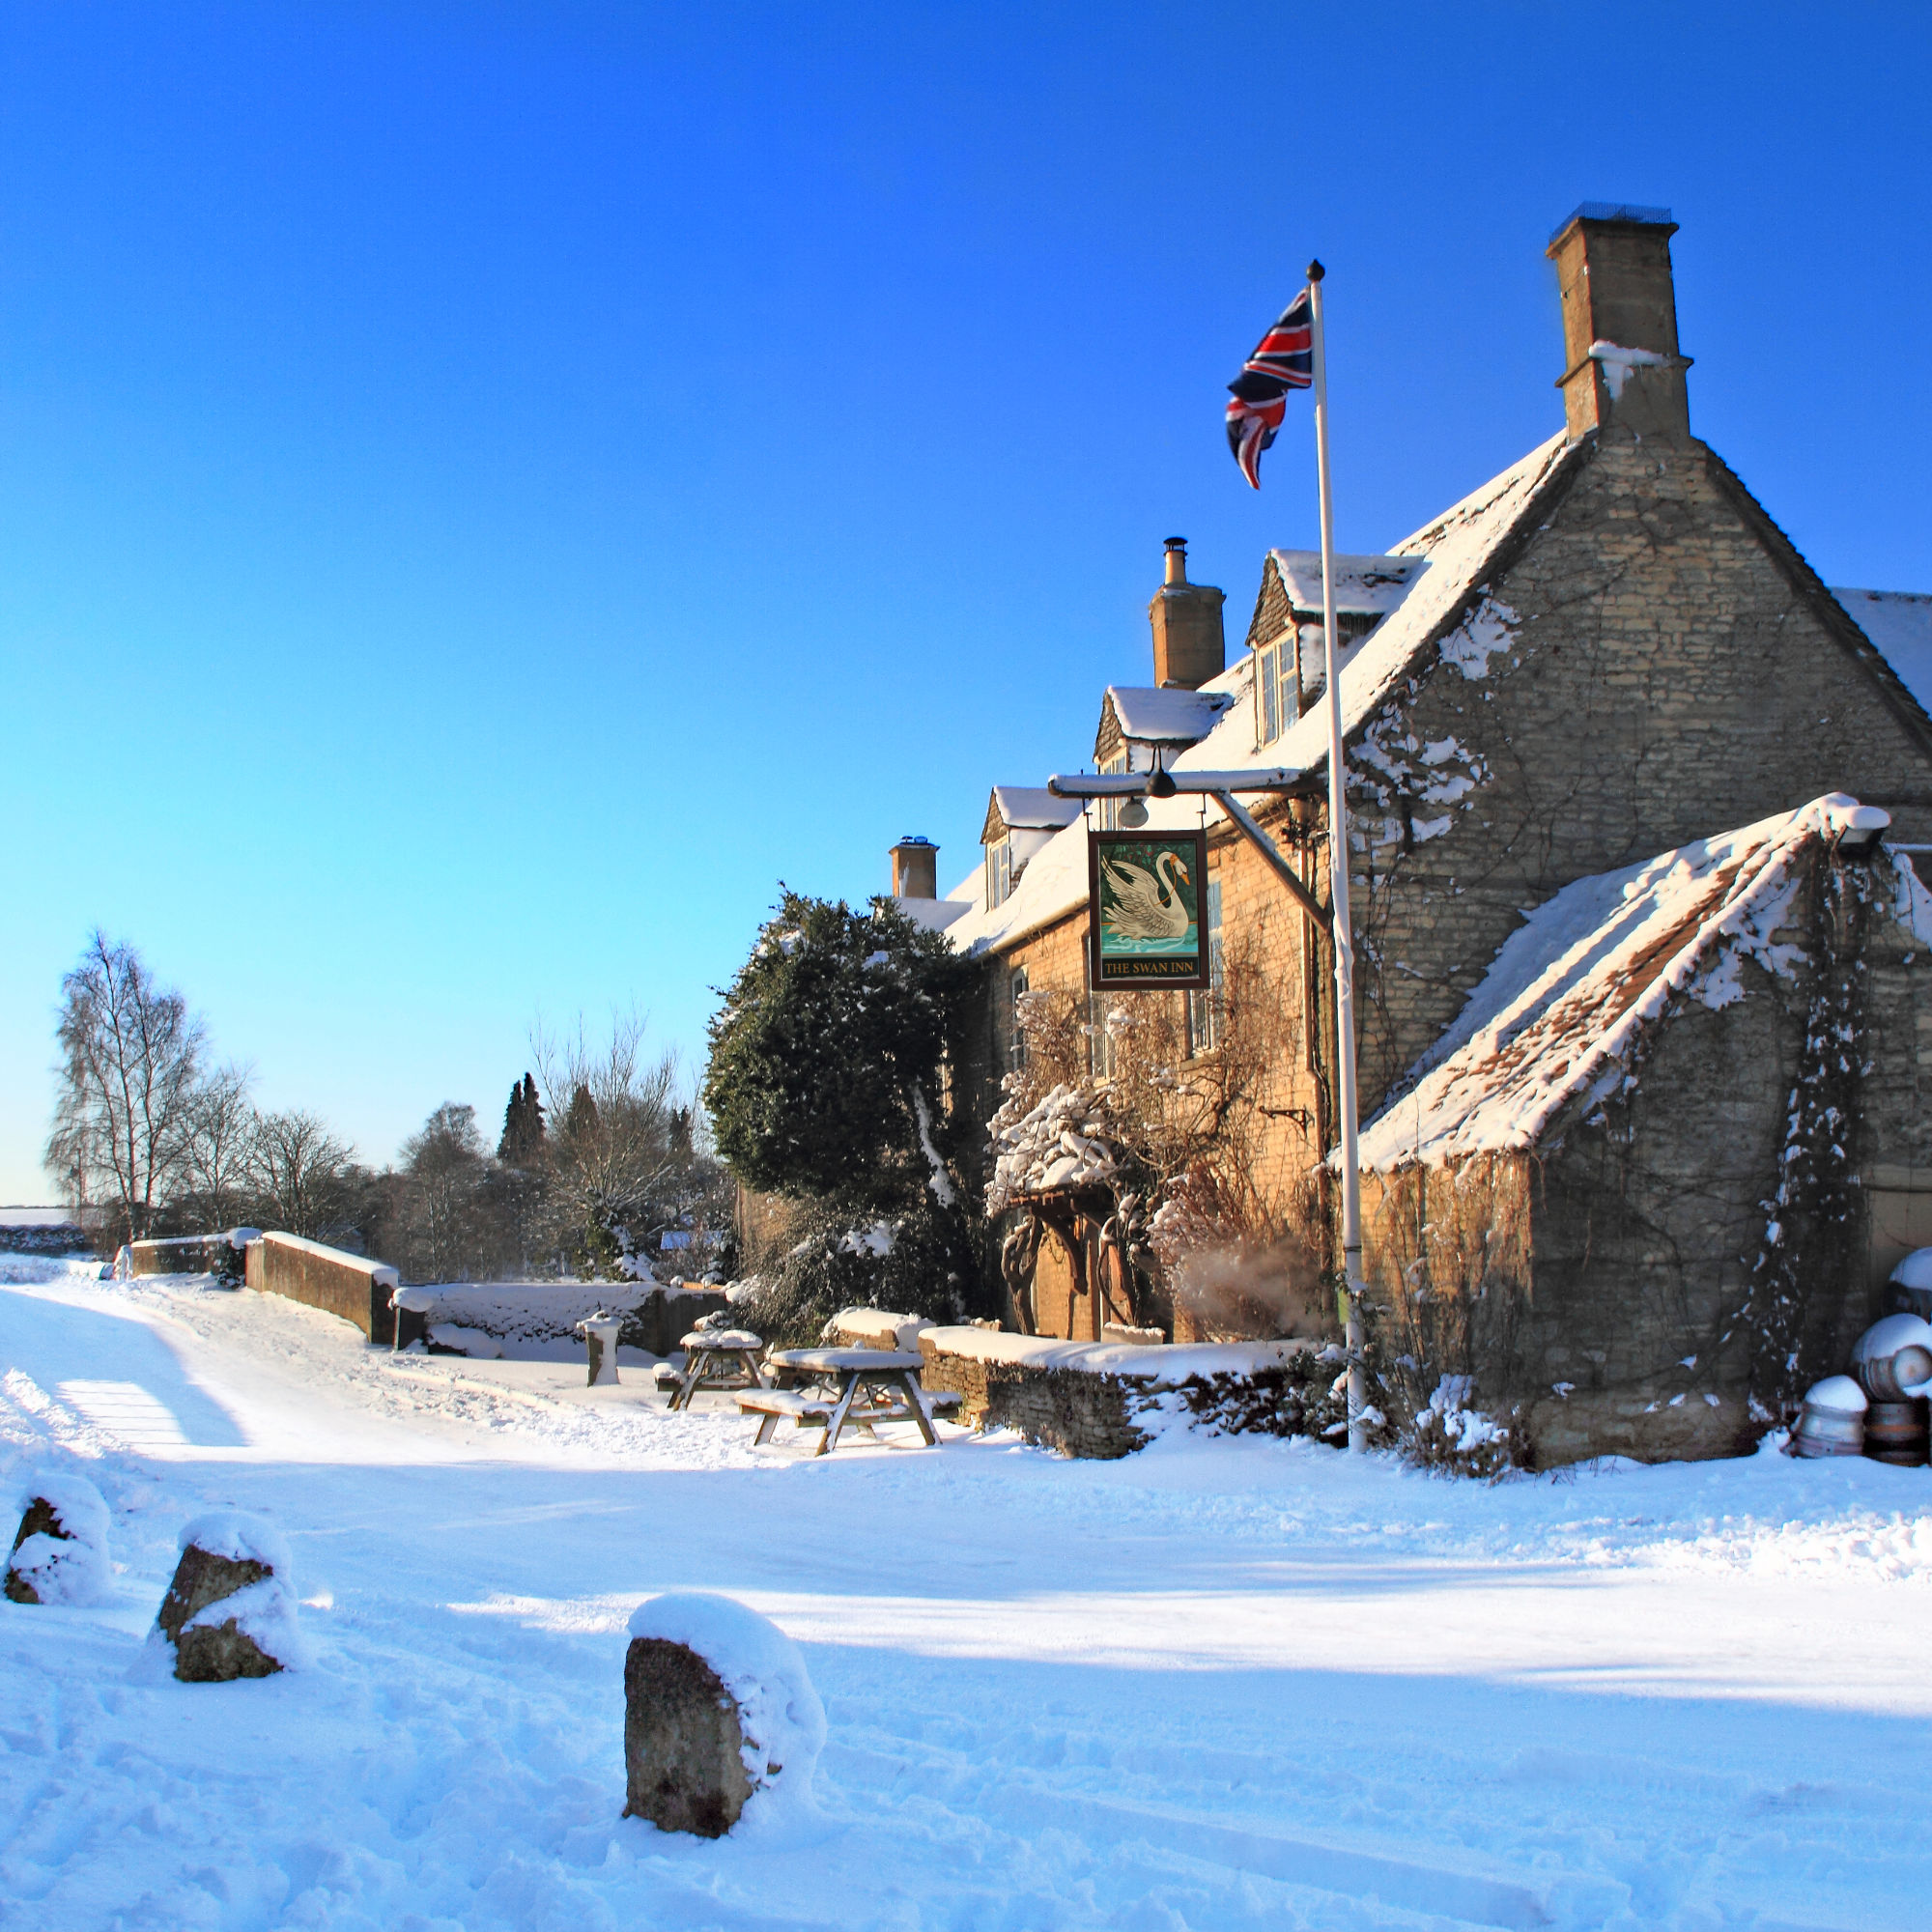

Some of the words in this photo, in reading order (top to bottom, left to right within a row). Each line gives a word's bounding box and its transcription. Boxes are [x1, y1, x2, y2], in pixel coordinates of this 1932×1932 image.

[1105, 963, 1130, 974] THE
[1132, 962, 1168, 974] SWAN
[1171, 962, 1193, 973] INN
